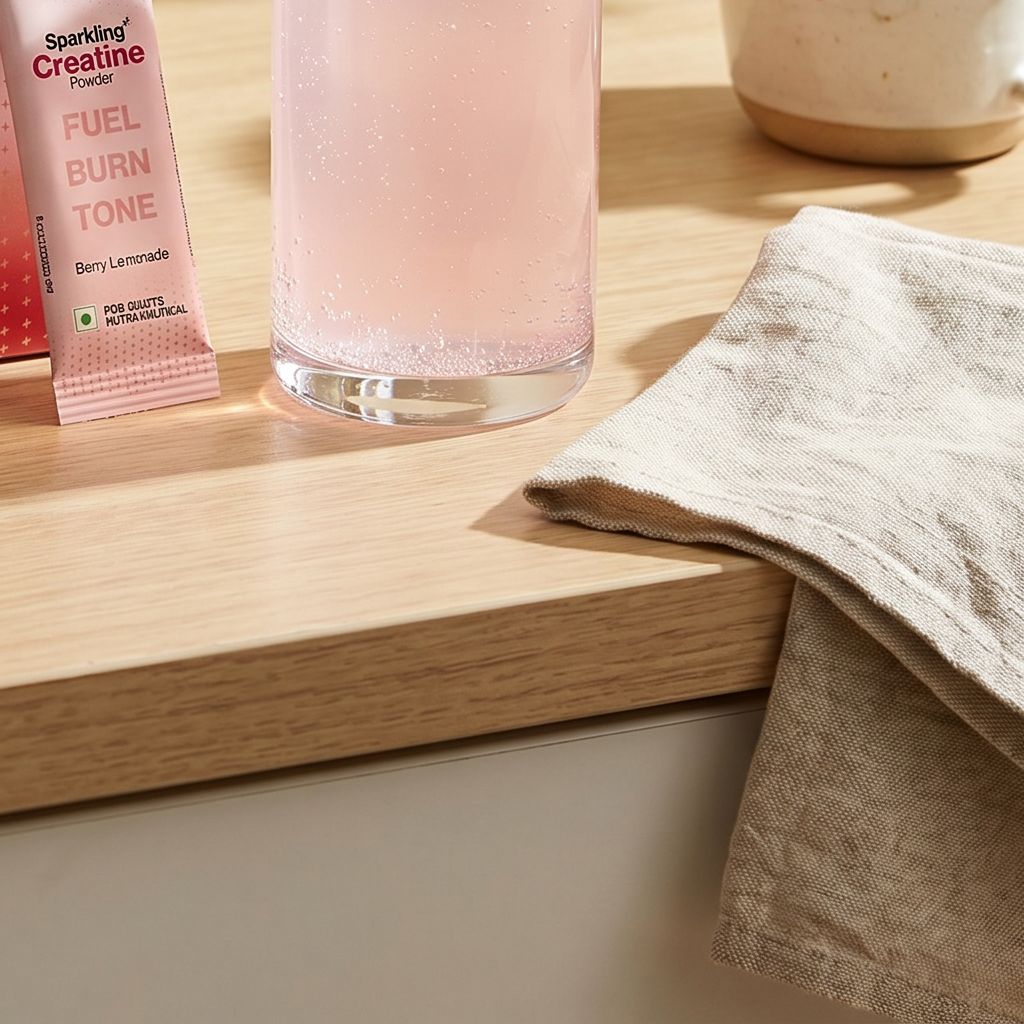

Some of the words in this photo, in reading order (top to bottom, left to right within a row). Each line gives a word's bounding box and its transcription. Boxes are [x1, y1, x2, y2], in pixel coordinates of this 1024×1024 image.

[32, 44, 145, 79] Creatine
[69, 72, 114, 90] Powder
[62, 104, 141, 141] FUEL
[65, 147, 152, 188] BURN
[71, 192, 158, 231] TONE
[75, 259, 107, 276] Berry
